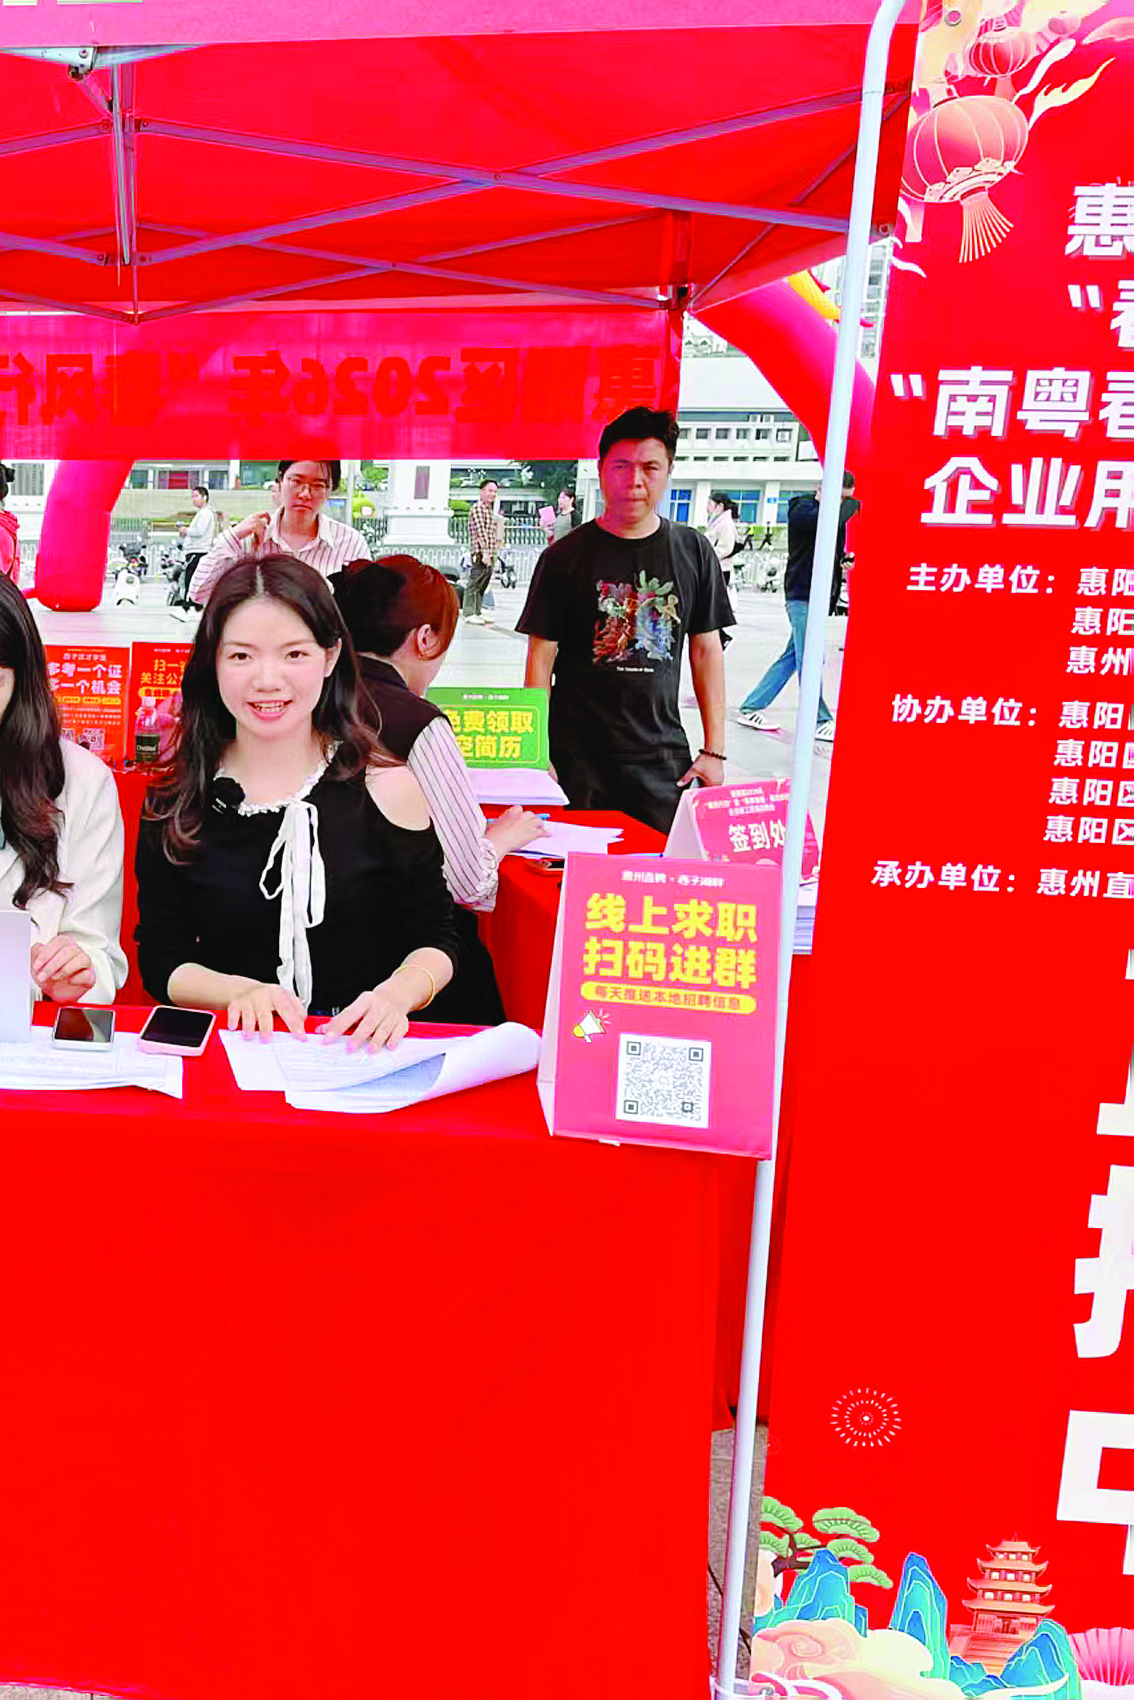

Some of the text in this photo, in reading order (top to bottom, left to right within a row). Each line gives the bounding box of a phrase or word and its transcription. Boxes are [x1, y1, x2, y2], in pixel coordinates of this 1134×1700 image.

[920, 455, 1134, 529] 企业用
[1071, 605, 1134, 636] 惠阳
[1066, 645, 1134, 676] 惠州
[141, 671, 183, 685] 关注公
[891, 693, 1134, 730] 协办单位：惠阳
[729, 819, 786, 852] 签到处
[585, 892, 758, 943] 线上求职
[582, 935, 758, 990] 扫码进群
[594, 985, 742, 1011] 每天推送本地招聘信息
